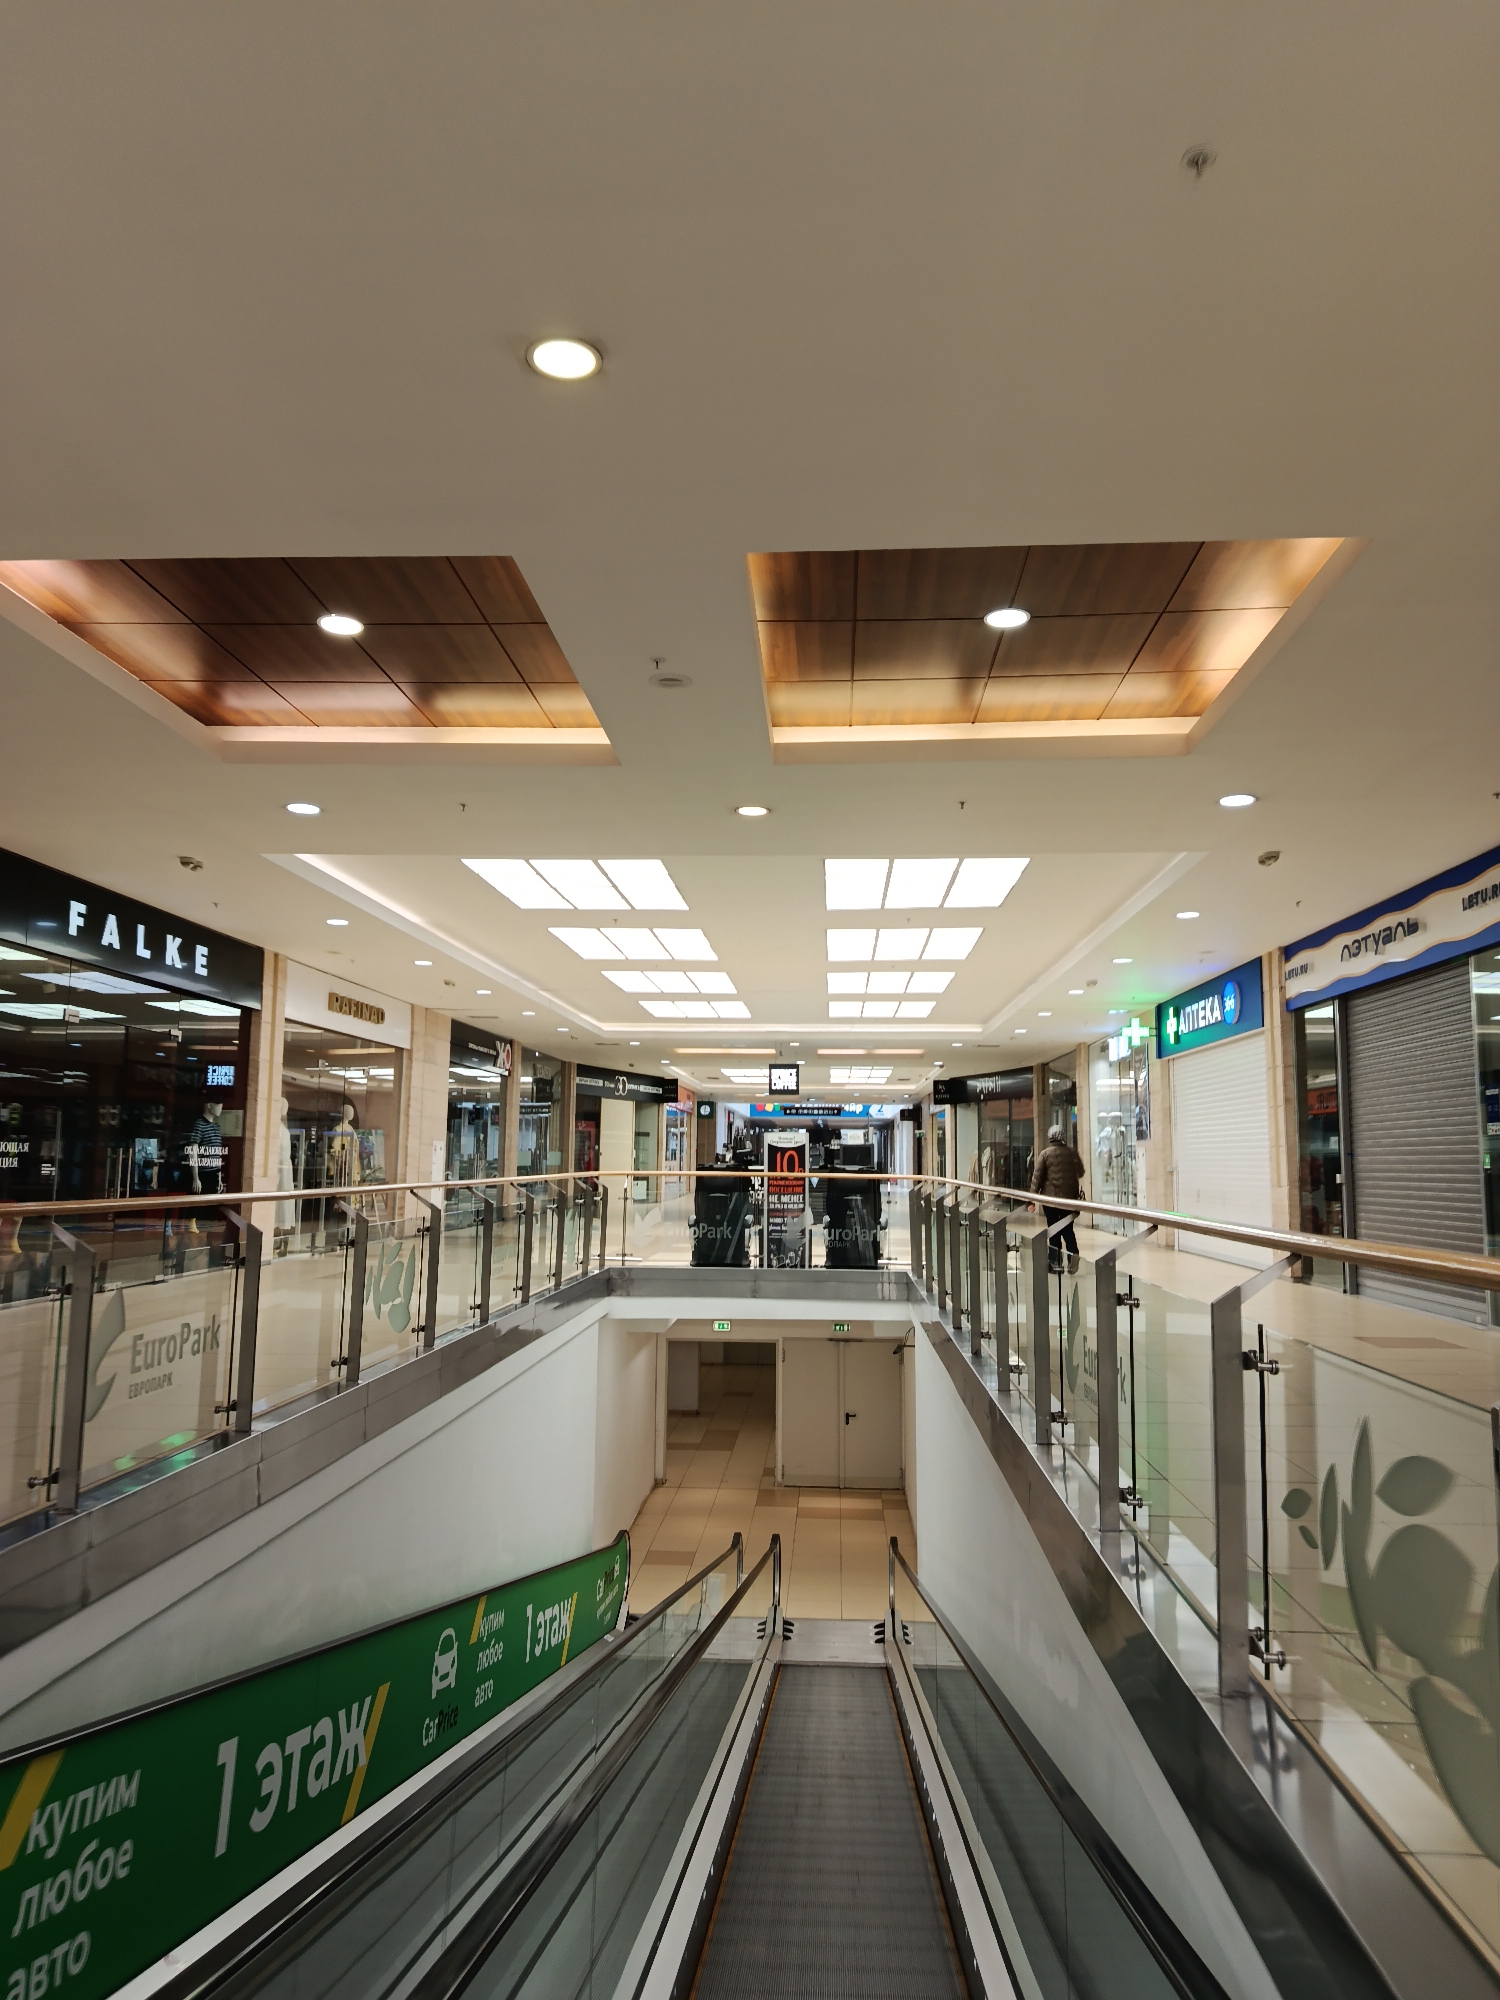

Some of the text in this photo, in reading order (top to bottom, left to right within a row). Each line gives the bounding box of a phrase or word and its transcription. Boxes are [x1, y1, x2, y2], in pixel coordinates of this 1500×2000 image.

[1462, 881, 1500, 911] LETU.R
[68, 900, 209, 977] FALKE
[1284, 962, 1309, 981] LETU.RU
[328, 992, 386, 1024] RAFINAD
[1178, 995, 1222, 1035] АПТЕКА
[781, 1194, 804, 1203] МЕНЕЕ
[130, 1314, 221, 1374] EuroPark
[128, 1372, 173, 1399] ЕВРОПАРК
[479, 1608, 505, 1642] купим
[525, 1597, 572, 1663] 1 этаж
[476, 1637, 504, 1673] любое
[474, 1679, 494, 1708] авто
[422, 1703, 459, 1747] CarPrice
[214, 1695, 372, 1859] 1 этаж
[11, 1838, 134, 1938] любое
[5, 1930, 92, 2000] авто
